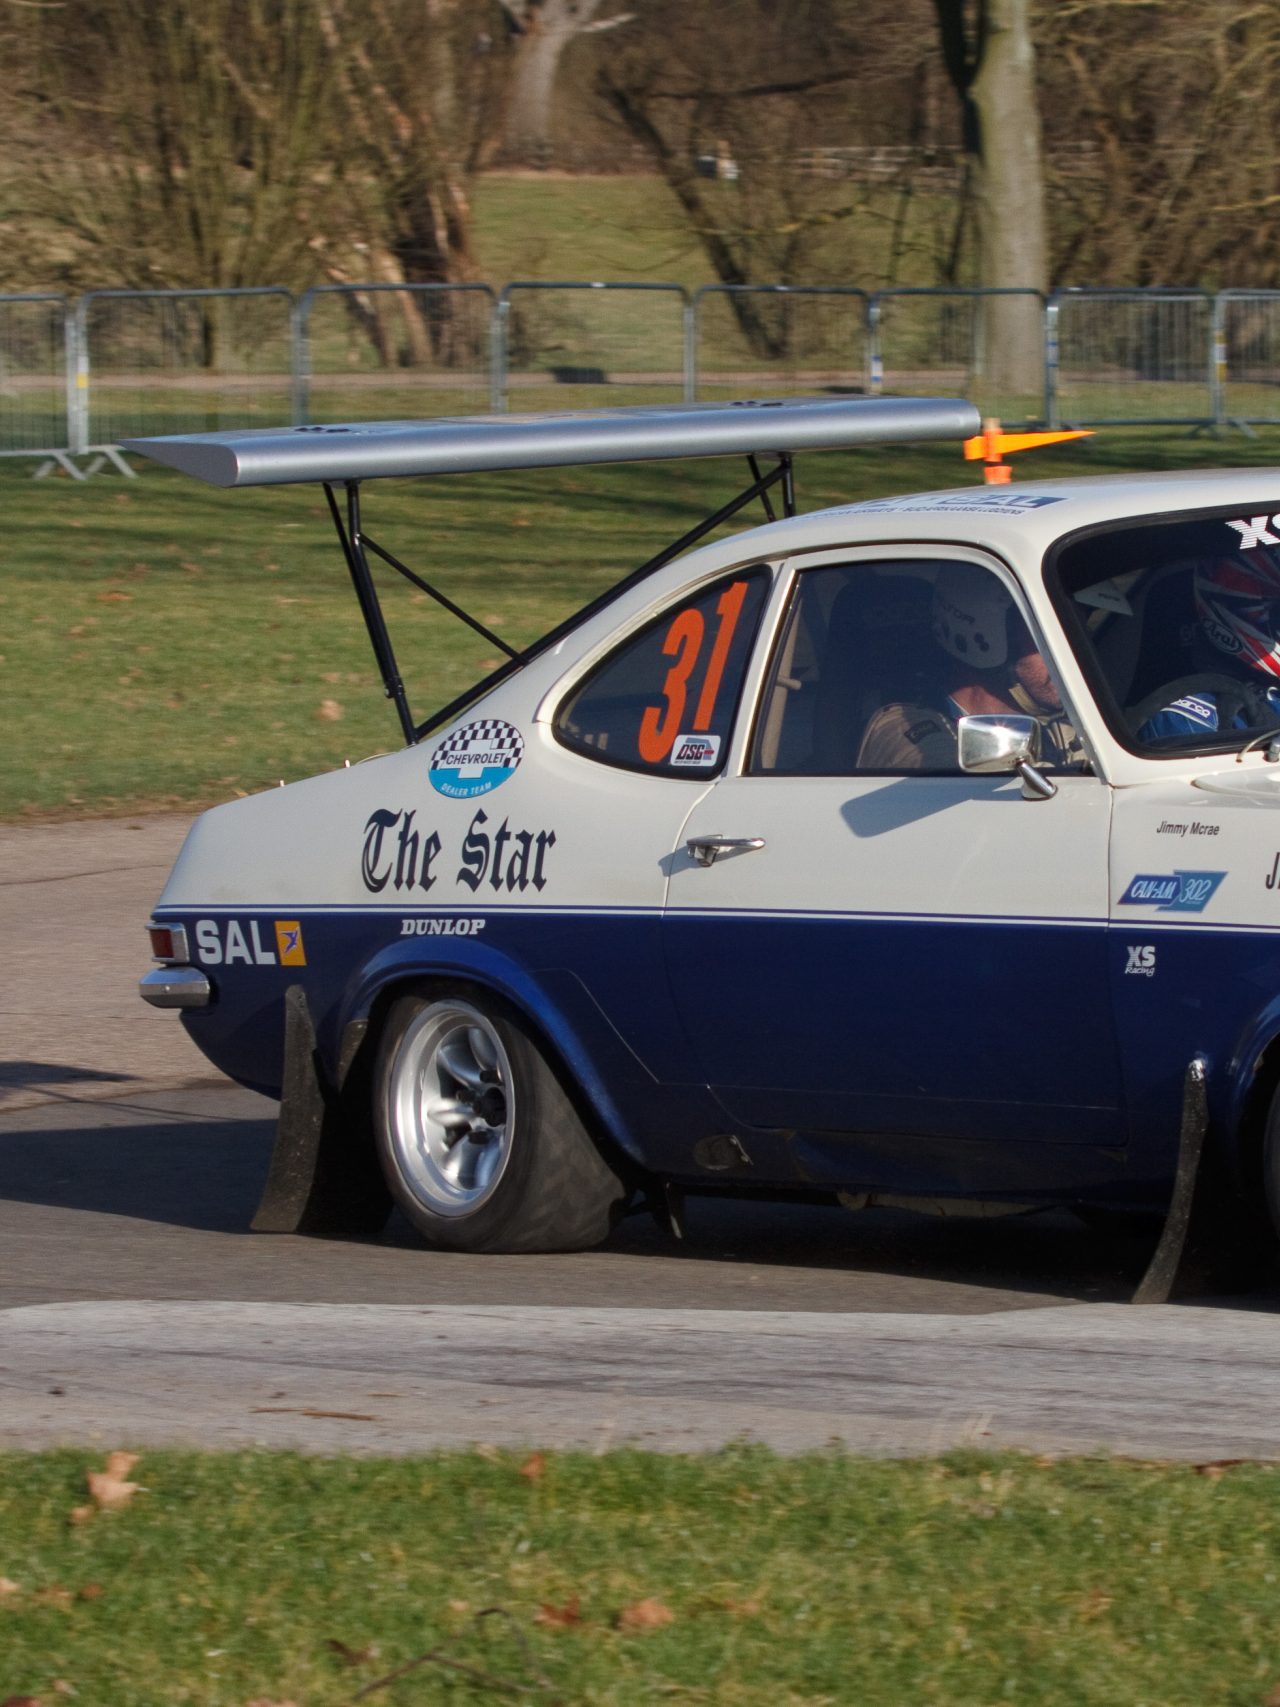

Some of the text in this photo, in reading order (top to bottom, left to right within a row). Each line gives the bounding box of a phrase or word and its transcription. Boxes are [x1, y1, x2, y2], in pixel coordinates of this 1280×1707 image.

[638, 582, 749, 764] 31
[446, 752, 505, 765] CHEVROLET
[441, 781, 492, 796] DEALER TEAM
[1156, 820, 1189, 838] Jimmy
[361, 808, 556, 894] The Star
[1179, 878, 1212, 902] 302
[401, 919, 486, 936] DUNLOP
[195, 920, 277, 965] SAL
[1126, 945, 1155, 967] XS
